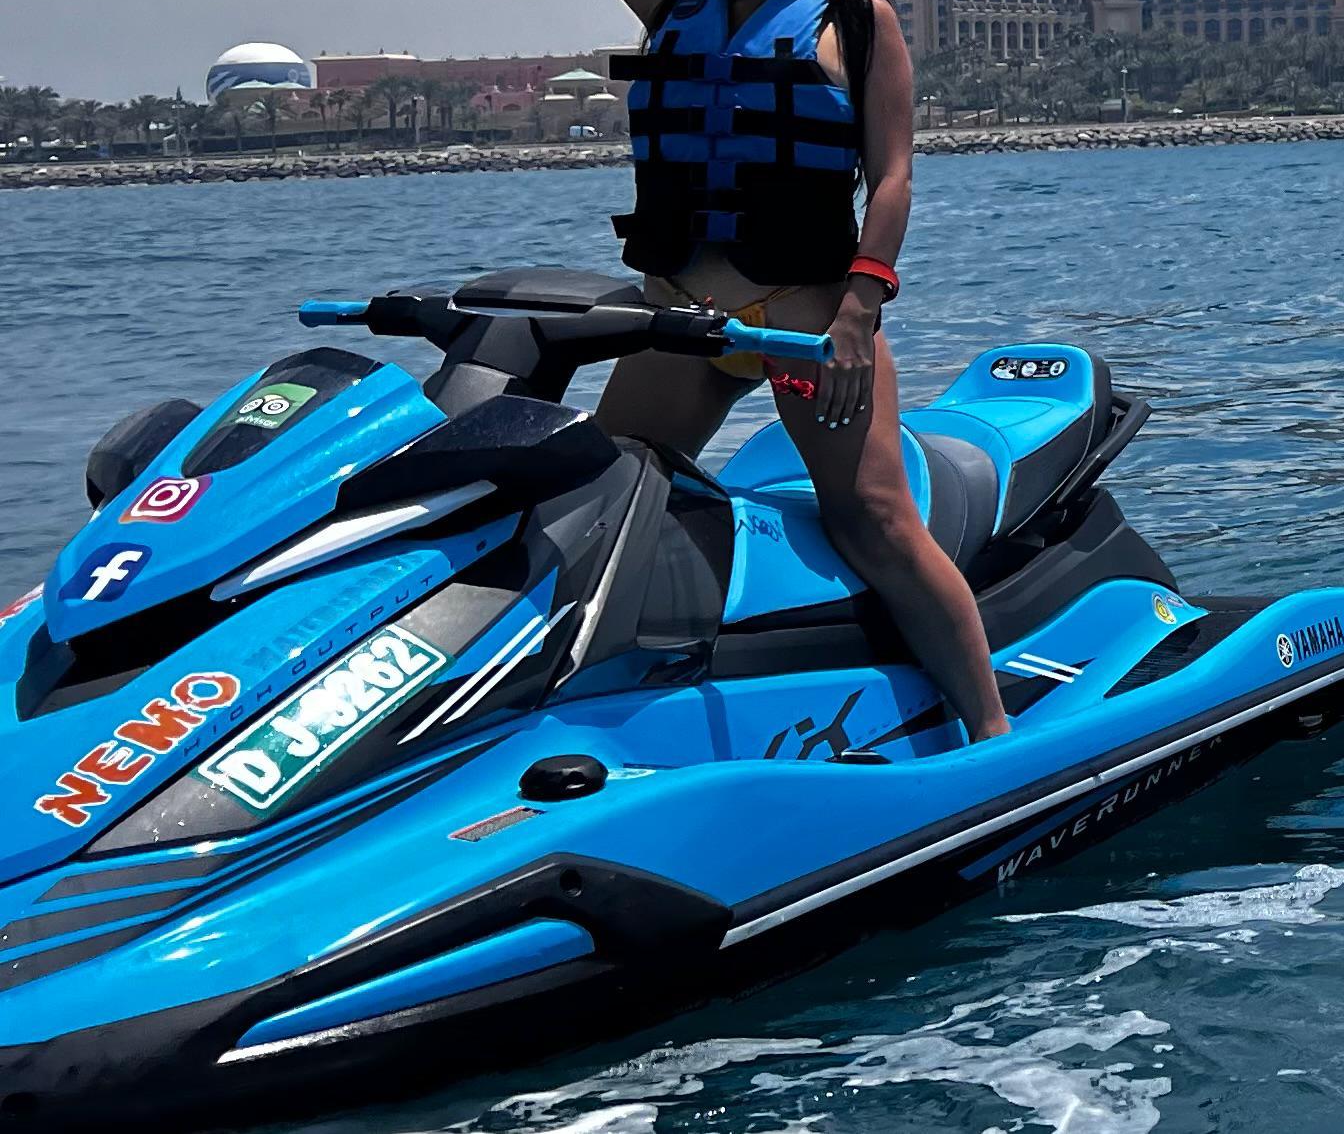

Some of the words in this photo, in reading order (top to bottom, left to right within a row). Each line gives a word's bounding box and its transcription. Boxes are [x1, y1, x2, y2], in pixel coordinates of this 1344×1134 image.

[1290, 616, 1344, 661] YAMAHA
[33, 671, 241, 827] NEMO
[216, 750, 281, 794] D
[271, 716, 320, 757] J
[998, 736, 1223, 882] WAVERUNNER
